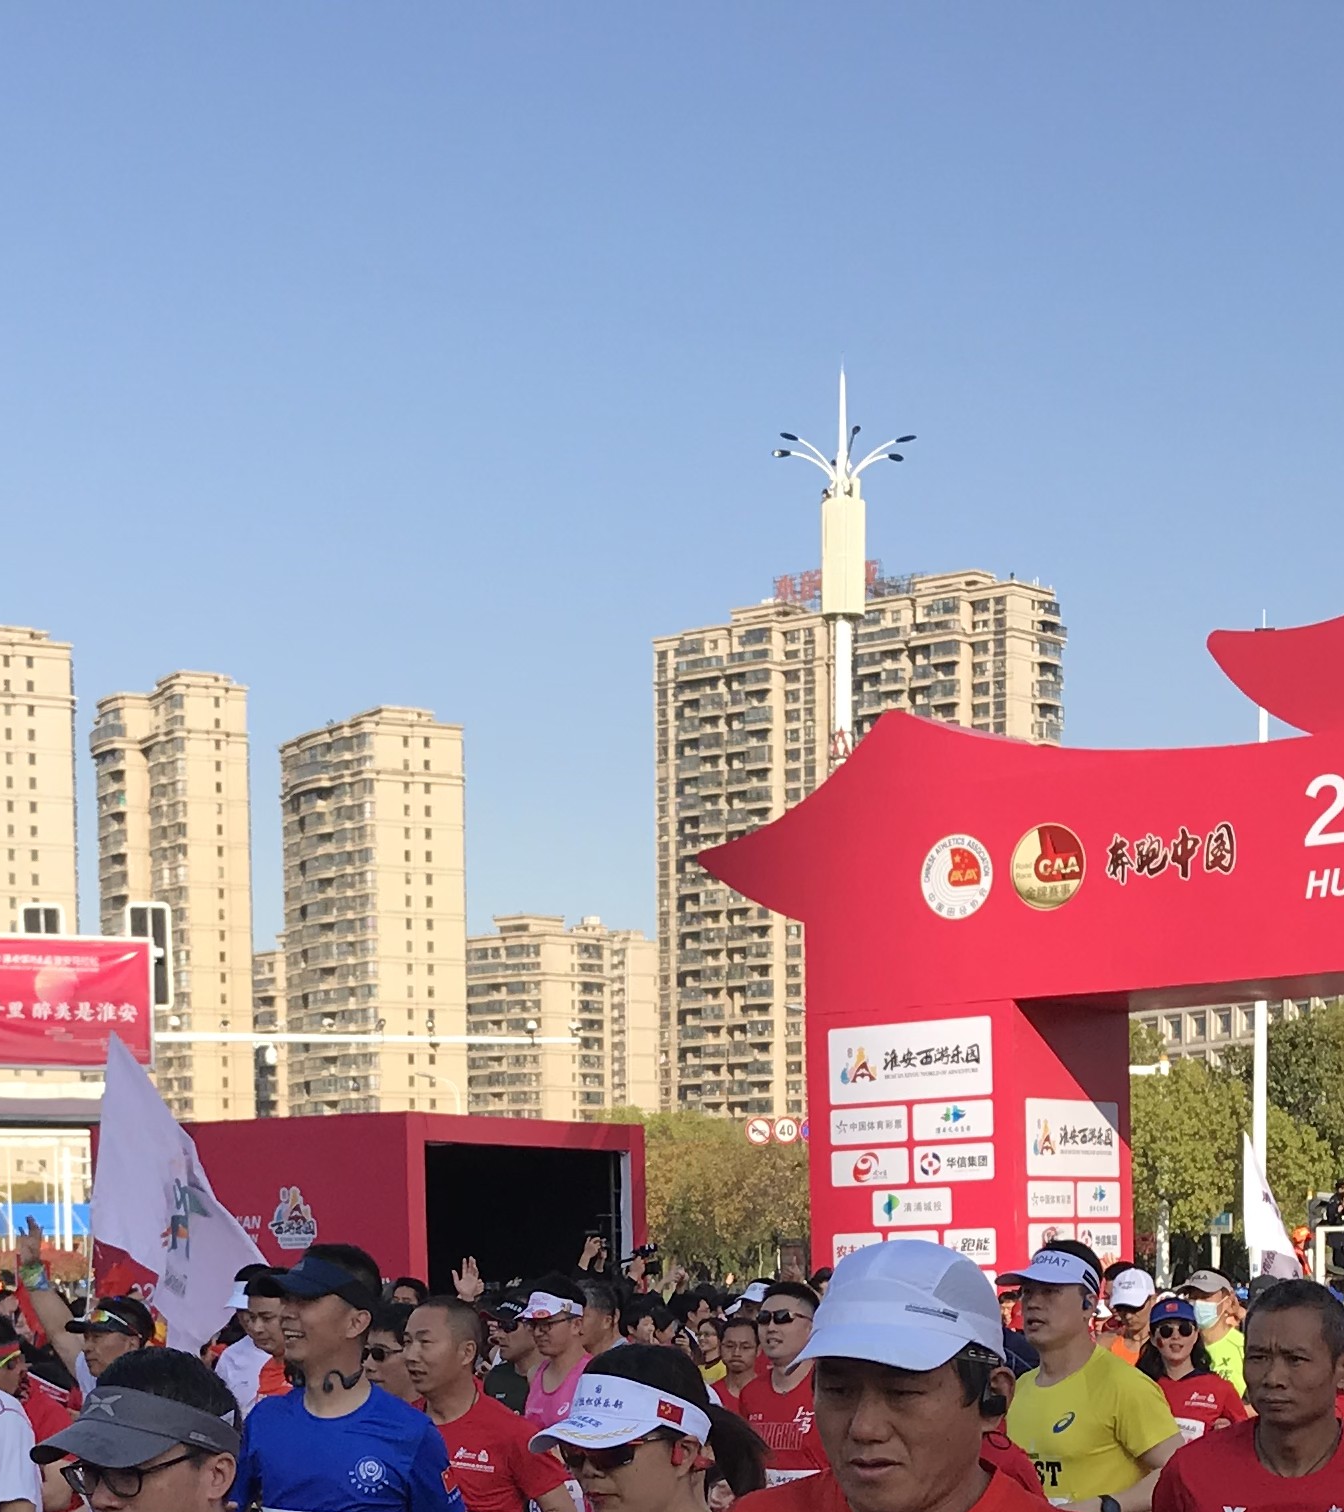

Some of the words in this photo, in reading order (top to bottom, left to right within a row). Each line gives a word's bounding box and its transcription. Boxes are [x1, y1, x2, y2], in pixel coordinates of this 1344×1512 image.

[934, 837, 966, 857] ATHLETICS
[1106, 821, 1237, 885] 奔跑中国
[1038, 855, 1081, 876] CAA
[1025, 883, 1072, 900] 金牌赛事
[882, 1043, 981, 1071] 淮安西游乐园
[779, 1124, 794, 1137] 40
[849, 1118, 903, 1132] 中国体育彩票
[1058, 1124, 1114, 1148] 淮安西游乐园
[946, 1155, 988, 1169] 华信集团
